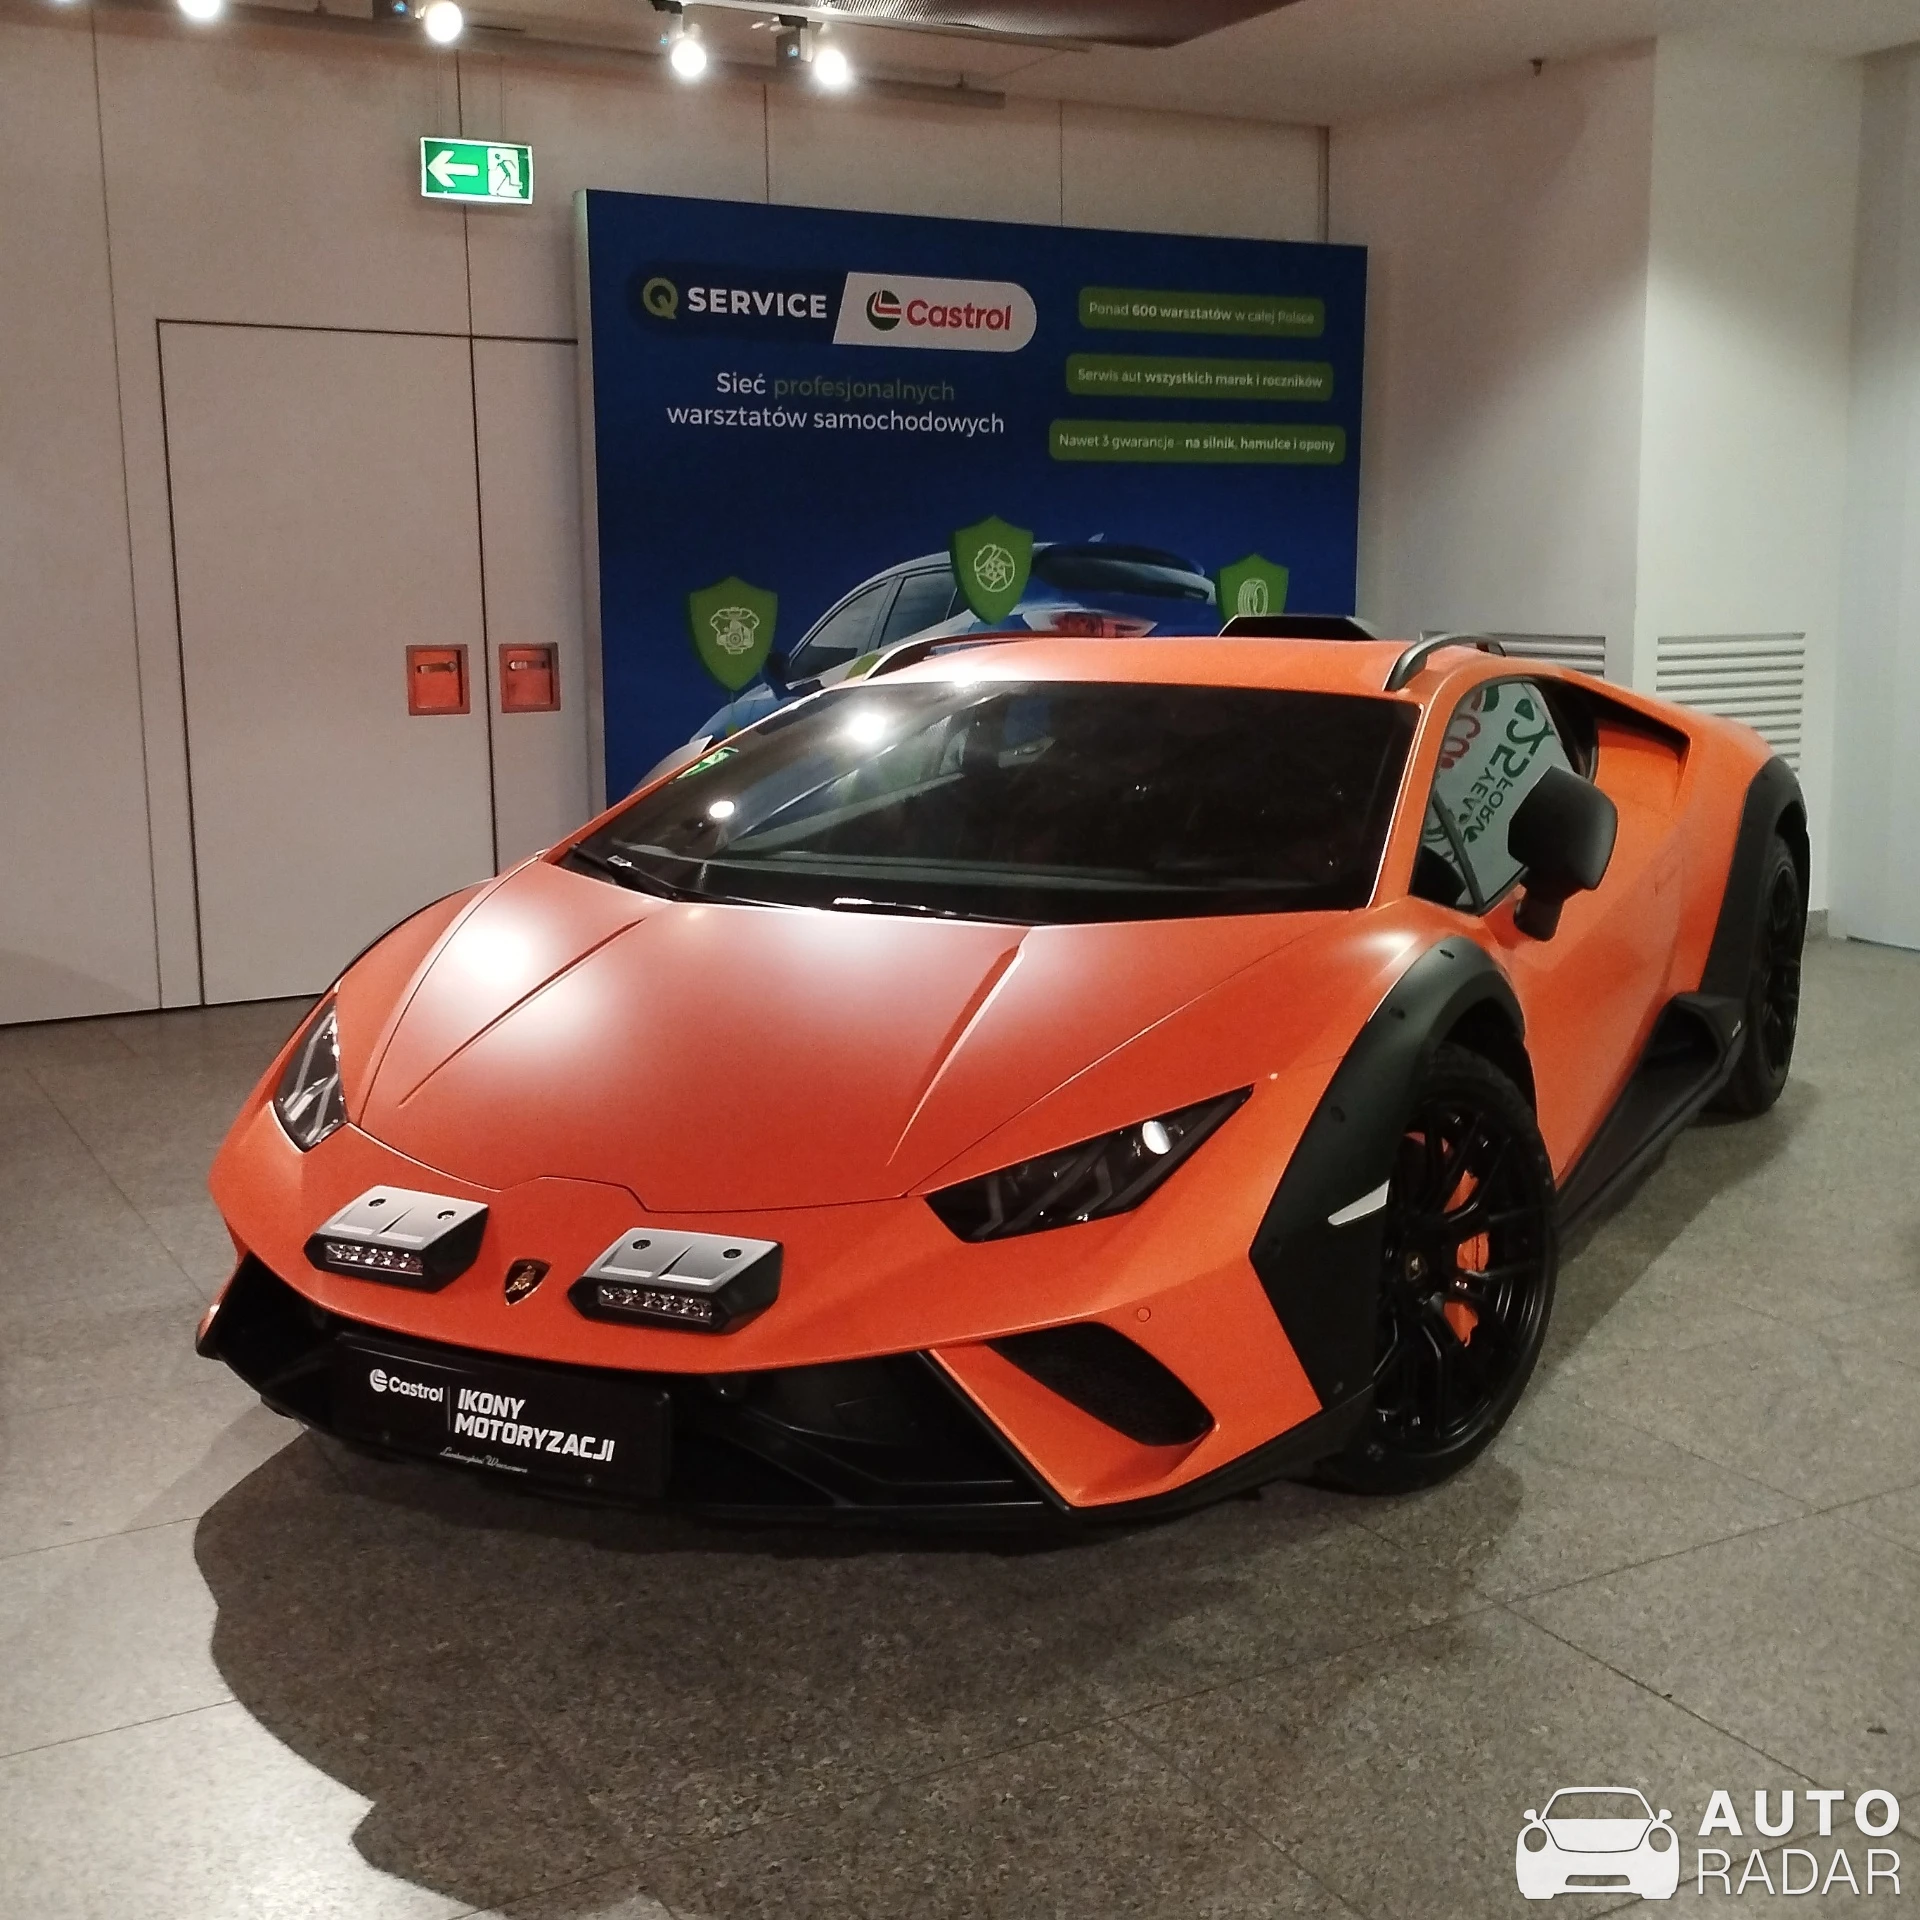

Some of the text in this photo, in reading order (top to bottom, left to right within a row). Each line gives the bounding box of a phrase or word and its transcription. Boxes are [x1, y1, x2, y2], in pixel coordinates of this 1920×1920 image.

[642, 277, 827, 320] Q SERVICE
[1089, 302, 1129, 317] Ponad
[1132, 304, 1157, 318] 600
[1160, 307, 1232, 321] warsztatów
[906, 299, 1013, 332] Castrol
[716, 371, 955, 405] Sieć profesjonalnych
[1078, 368, 1119, 381] Serwis
[1121, 371, 1141, 383] aut
[1144, 371, 1213, 387] wszystkich
[1215, 373, 1253, 386] marek
[666, 405, 1005, 438] warsztatów samochodowych
[1059, 433, 1099, 447] Nawet
[1102, 434, 1110, 447] 3
[1112, 434, 1175, 451] gwarancje
[1185, 438, 1201, 449] na
[1240, 437, 1292, 450] hamulce
[1299, 439, 1336, 454] opony
[388, 1376, 444, 1403] Castrol
[457, 1388, 526, 1420] IKONY
[454, 1413, 616, 1462] MOTORYZACJI
